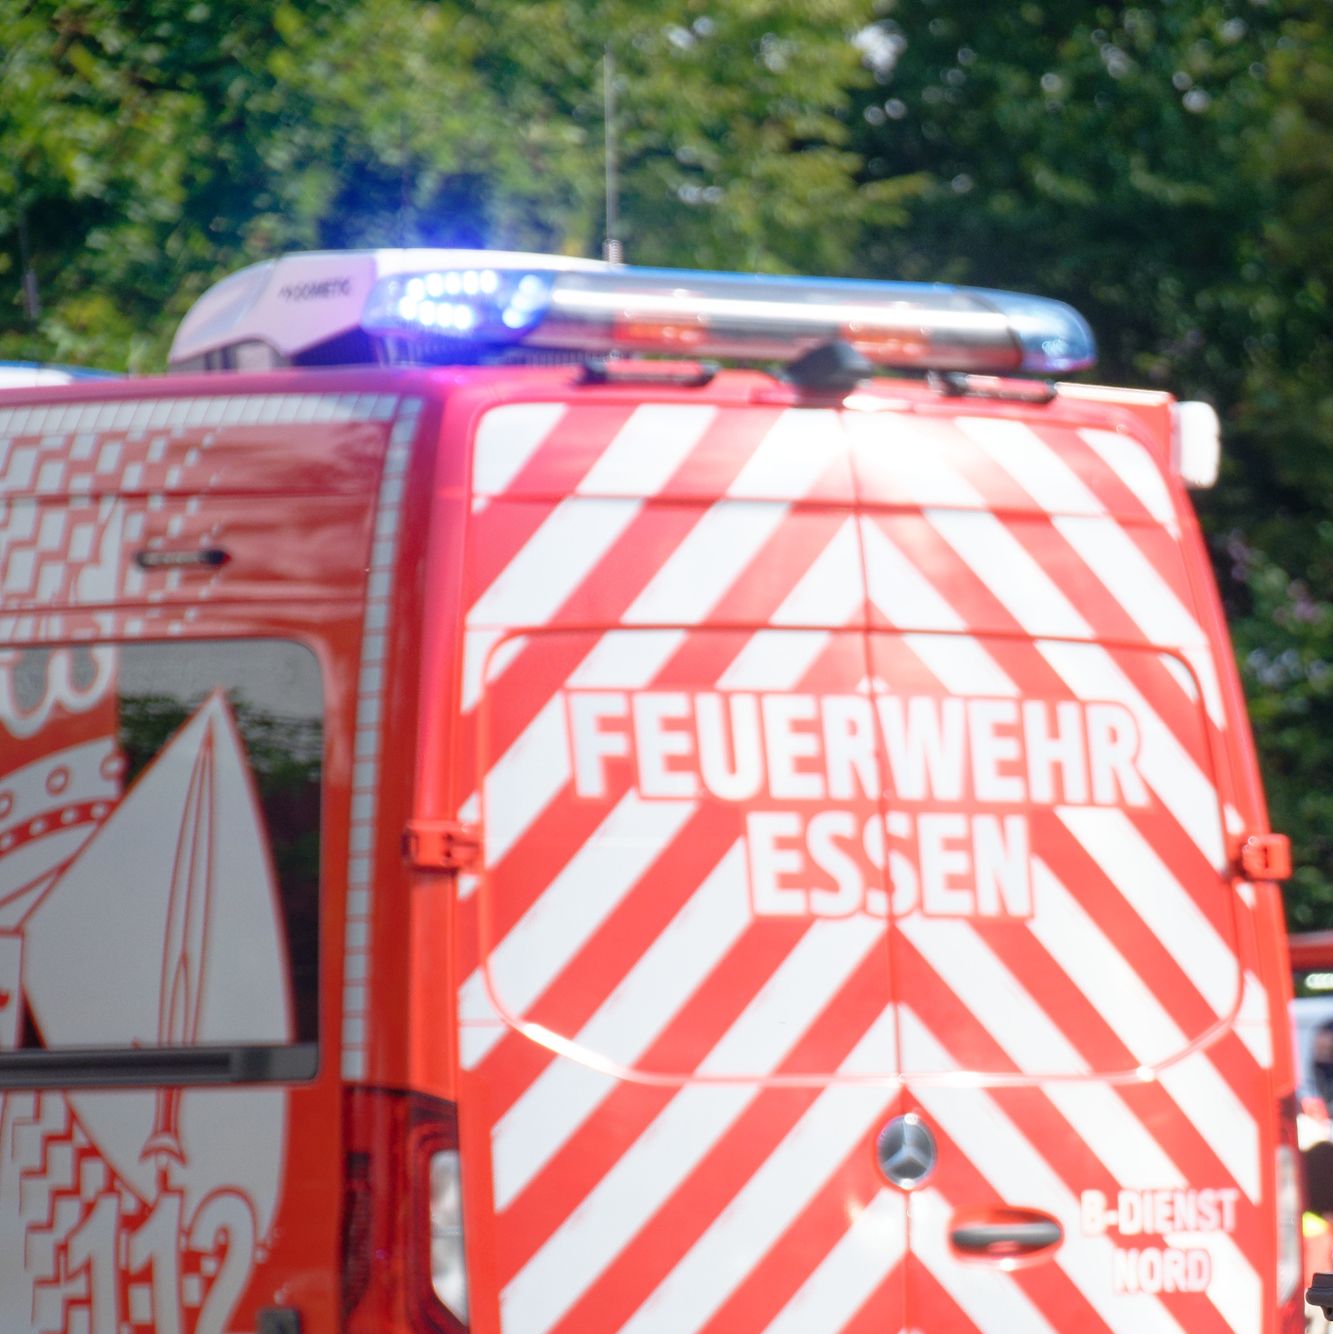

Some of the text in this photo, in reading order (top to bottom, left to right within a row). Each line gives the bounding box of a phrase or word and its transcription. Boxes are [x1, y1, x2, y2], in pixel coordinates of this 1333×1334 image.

[567, 693, 1148, 806] FEUERWEHR
[747, 811, 1034, 919] ESSEN
[1081, 1187, 1237, 1236] B-DIENST
[1114, 1247, 1211, 1295] NORD
